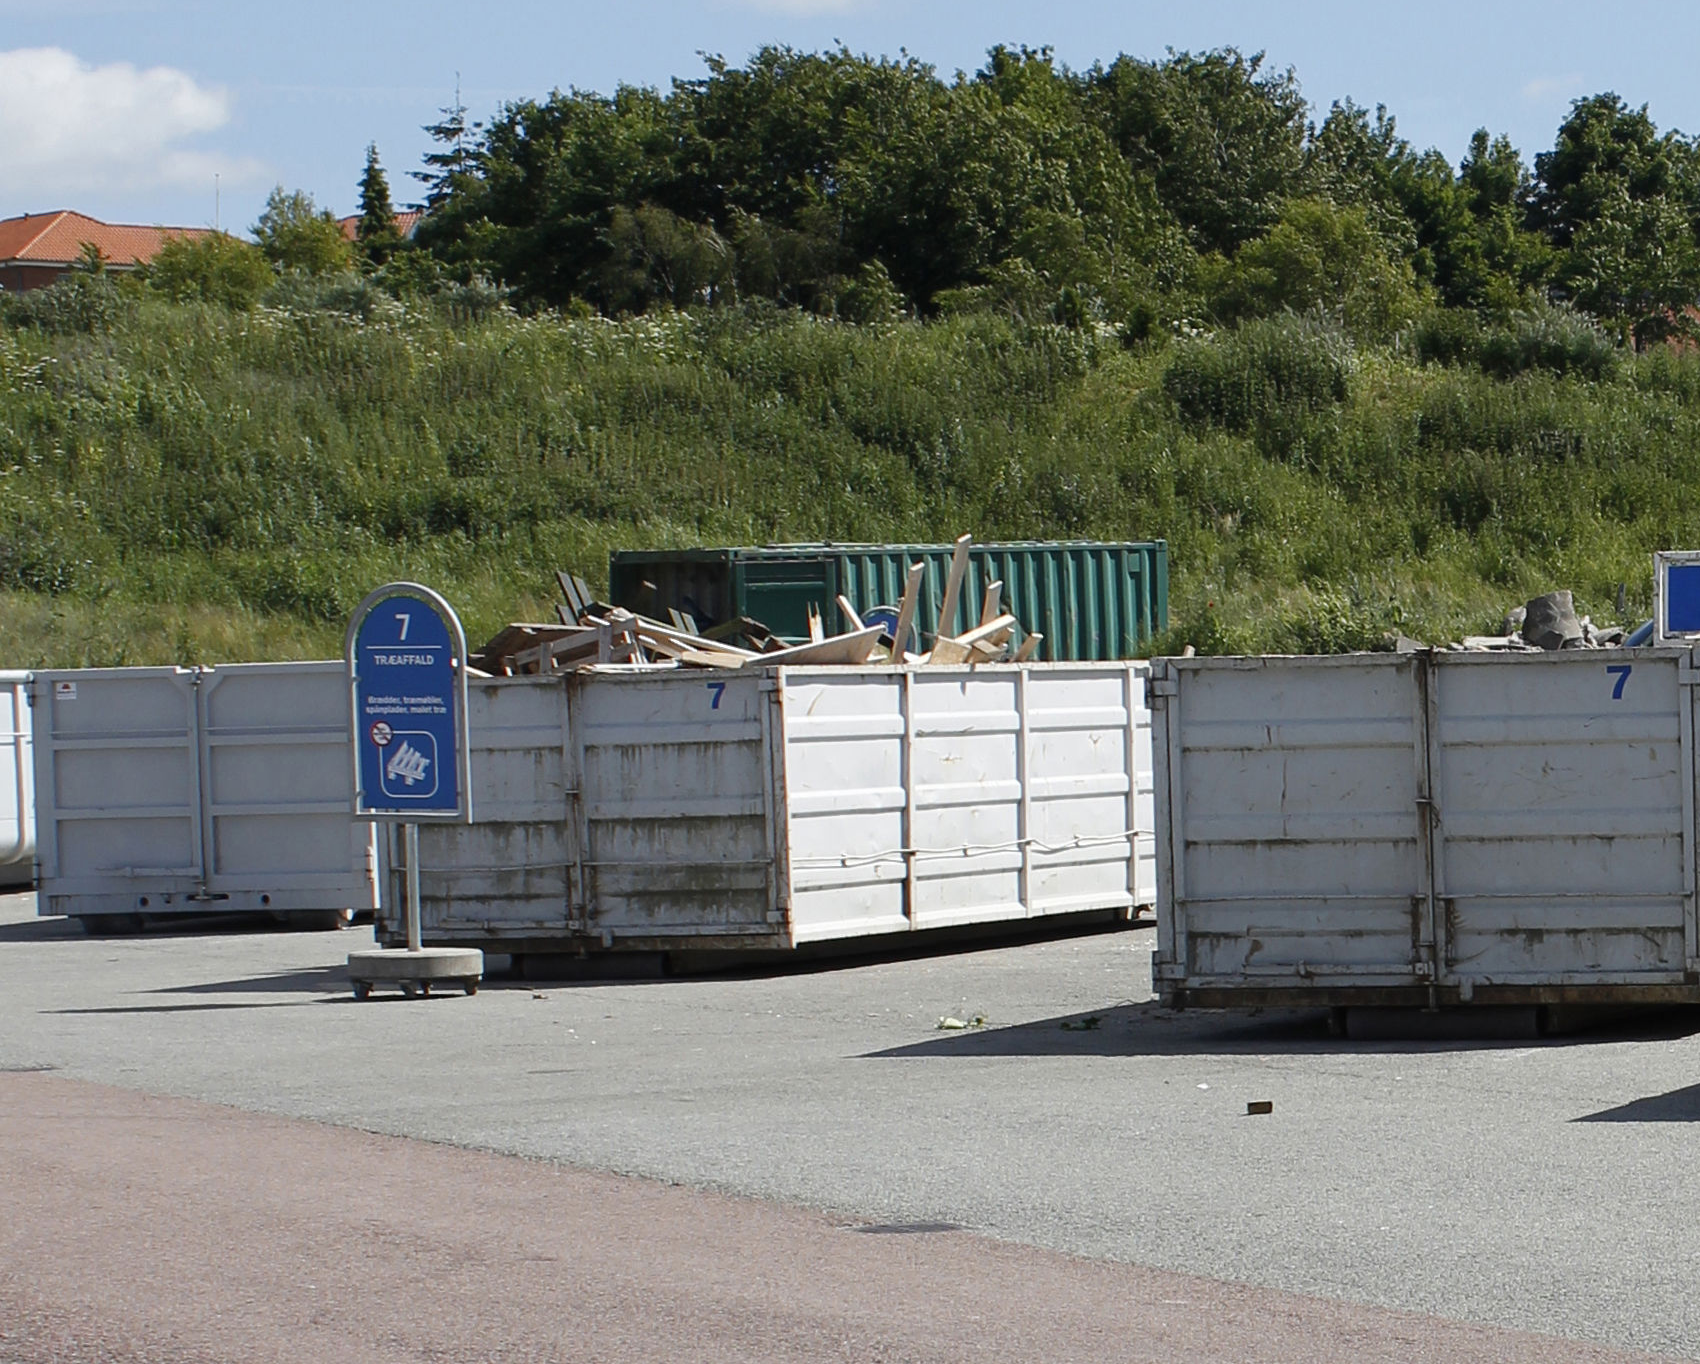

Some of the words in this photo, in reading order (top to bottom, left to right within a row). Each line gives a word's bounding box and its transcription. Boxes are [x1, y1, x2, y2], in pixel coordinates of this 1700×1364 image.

[394, 613, 411, 641] 7
[373, 654, 435, 666] TRÆAFFALD
[706, 682, 726, 710] 7
[1606, 664, 1633, 700] 7
